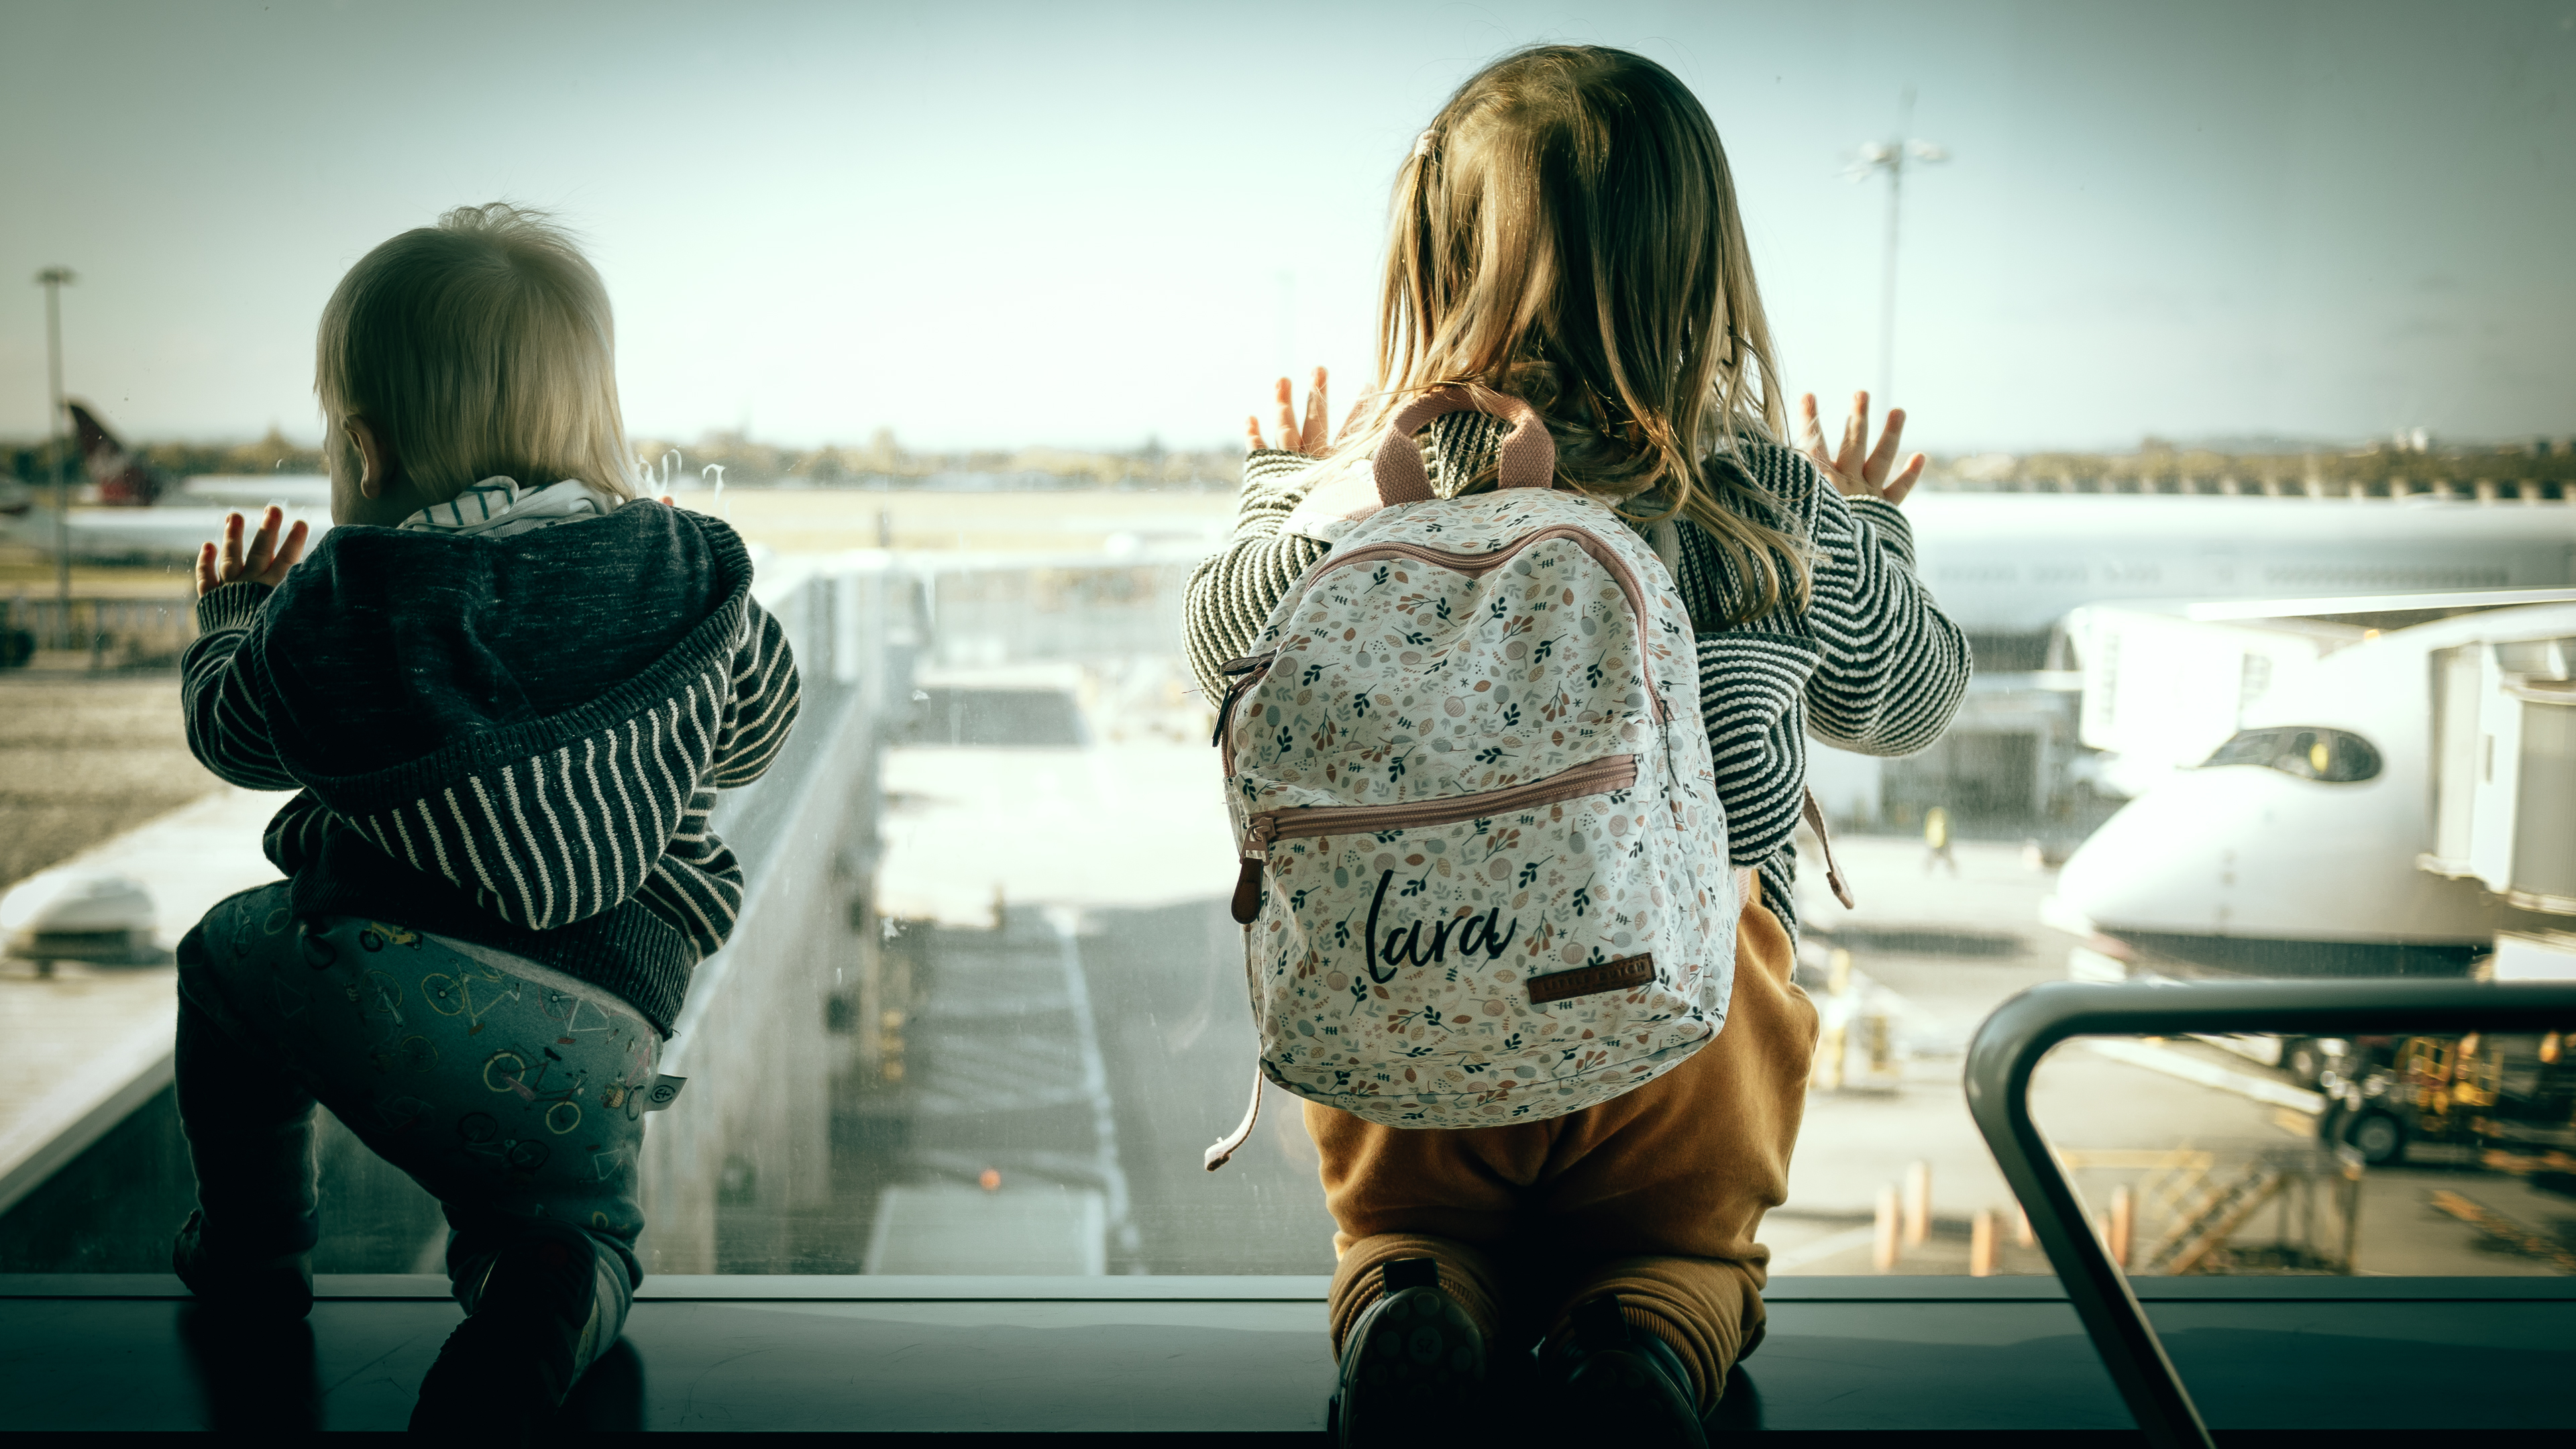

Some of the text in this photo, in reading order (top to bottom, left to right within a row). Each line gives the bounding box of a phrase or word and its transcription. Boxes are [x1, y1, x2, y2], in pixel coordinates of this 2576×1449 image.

[1364, 869, 1517, 984] Lara
[1598, 961, 1645, 981] DUTCH
[1417, 1338, 1434, 1354] 25
